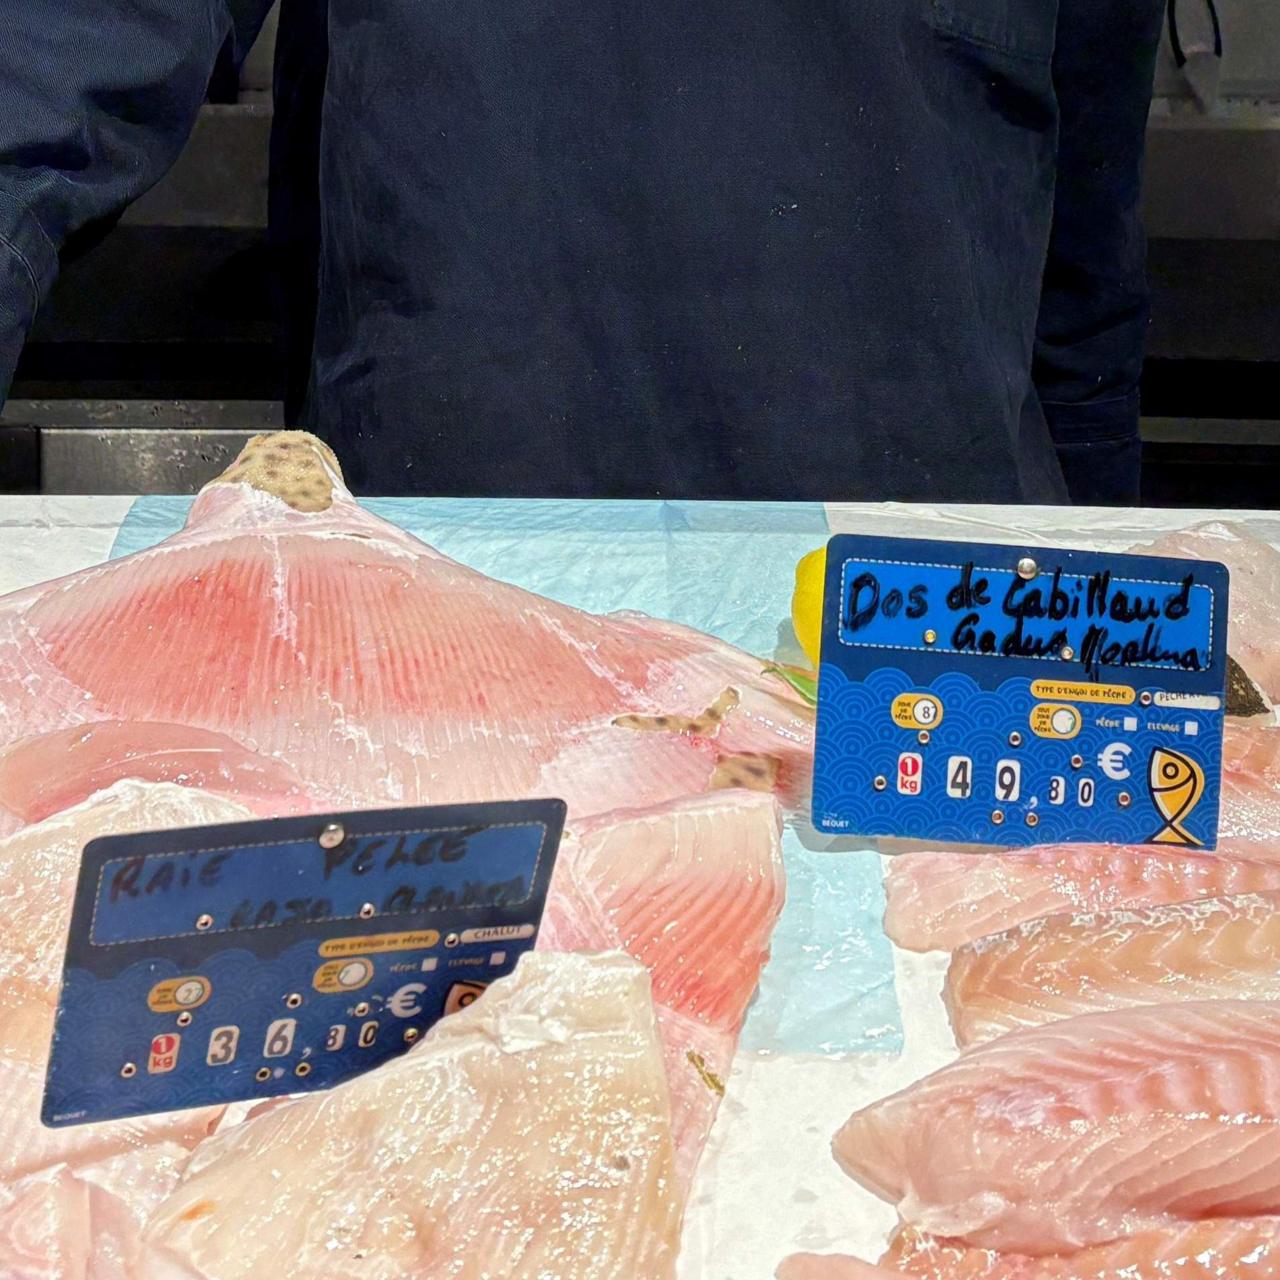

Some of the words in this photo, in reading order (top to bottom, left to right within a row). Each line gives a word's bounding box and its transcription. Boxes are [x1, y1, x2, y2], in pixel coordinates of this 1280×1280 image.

[843, 571, 929, 632] Dos
[946, 560, 993, 613] de
[1001, 566, 1196, 623] Cabillaud
[1096, 741, 1132, 781] €
[900, 777, 918, 793] kg
[386, 981, 428, 1019] €
[152, 1056, 175, 1070] kg
